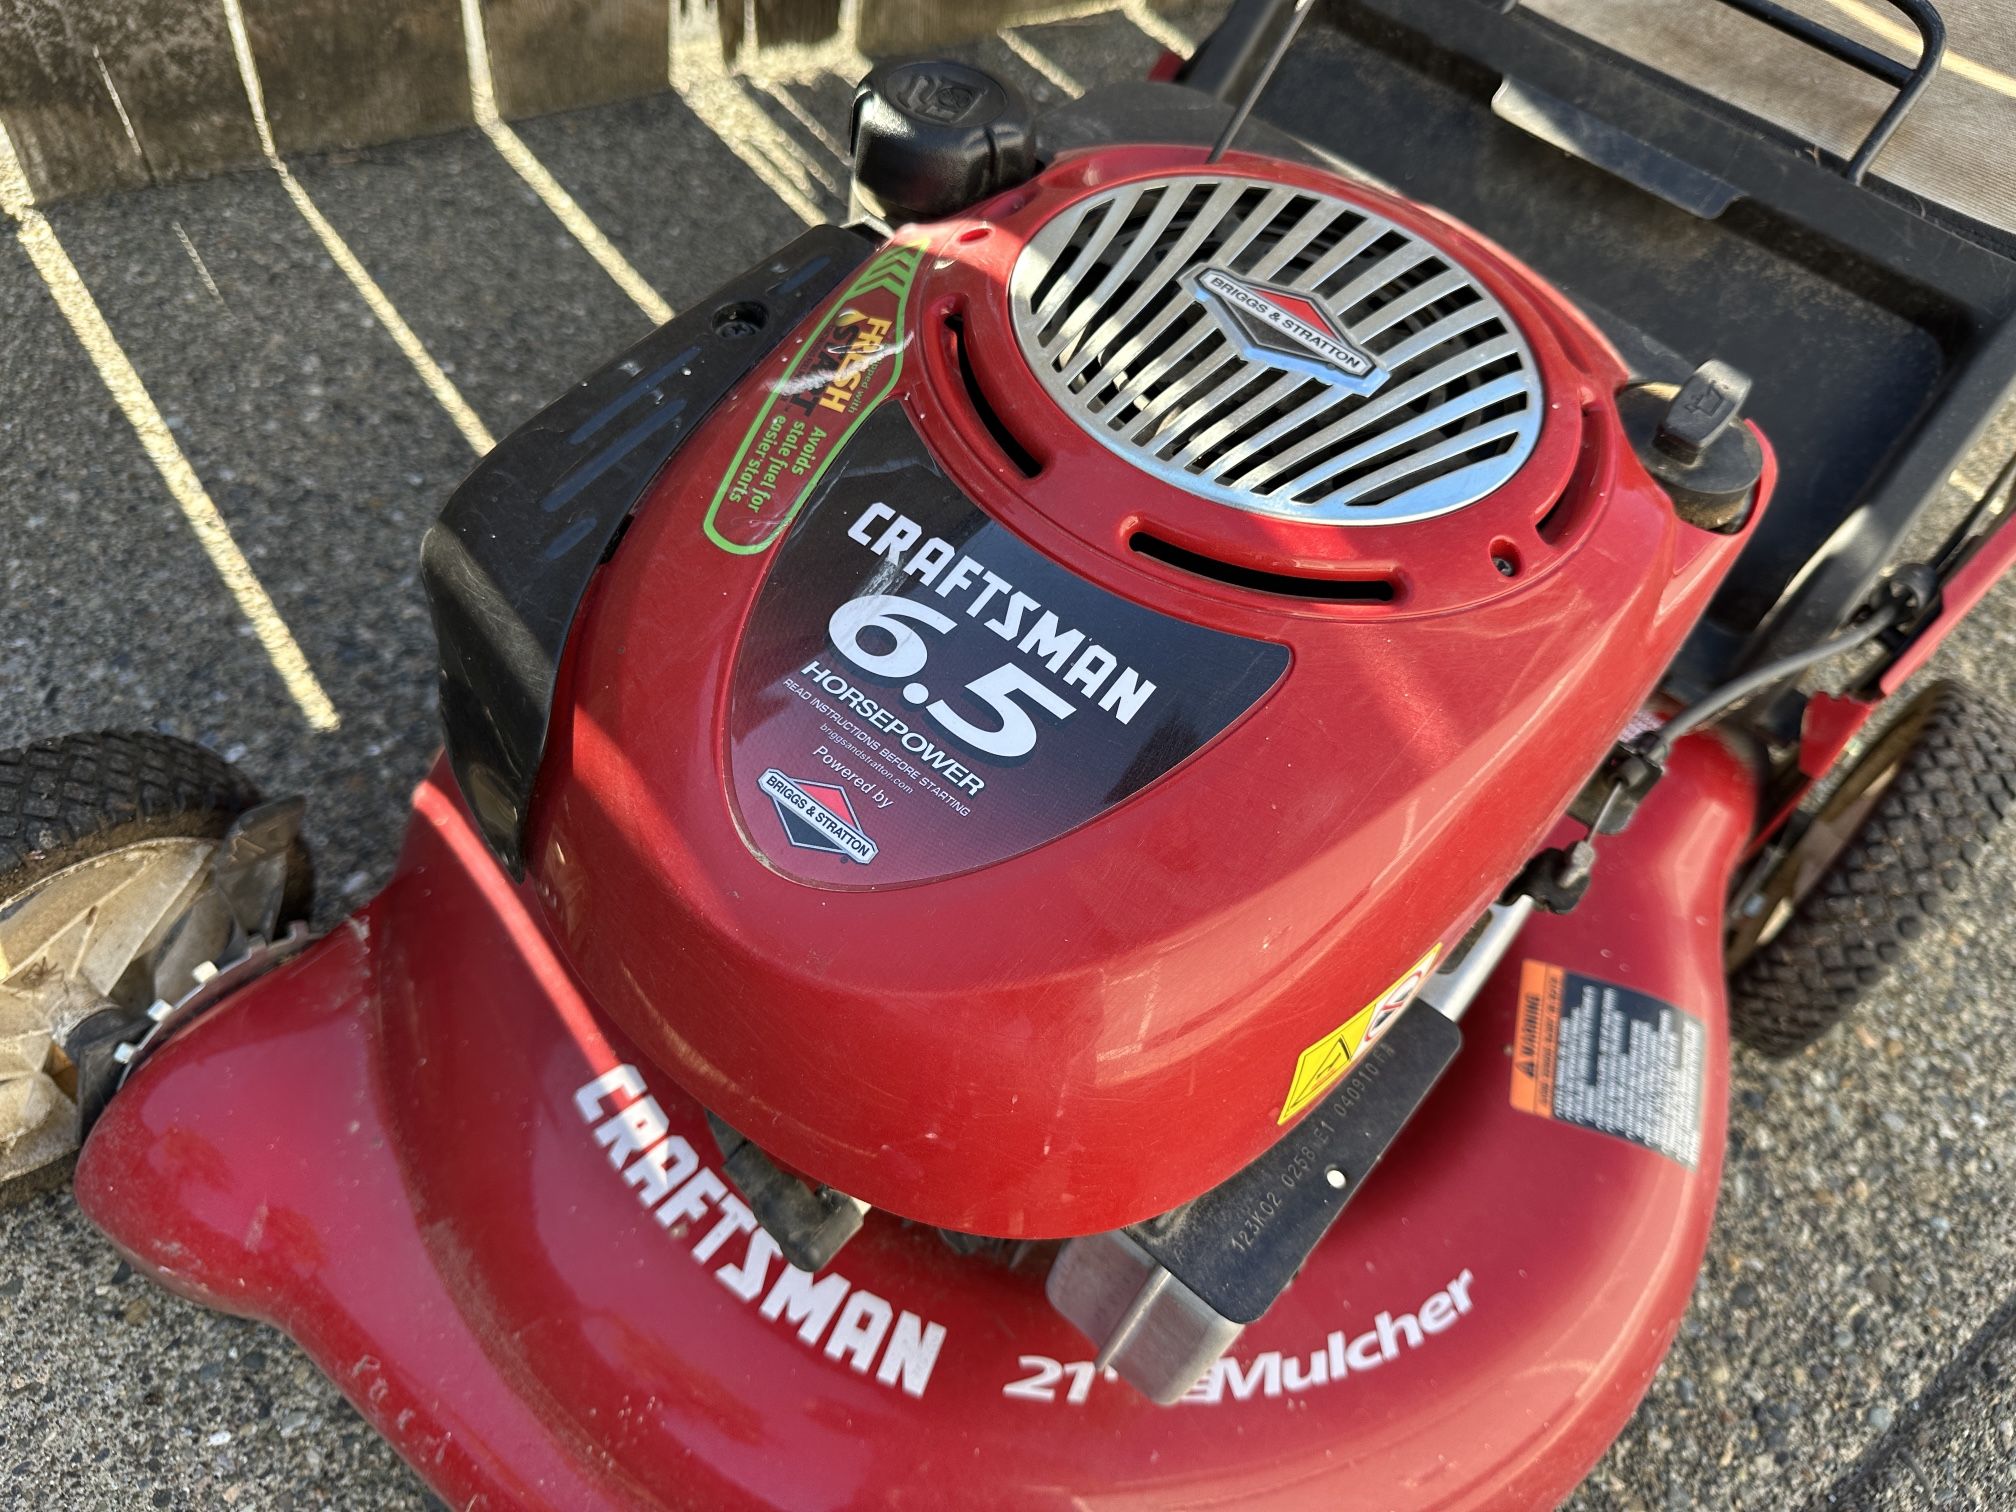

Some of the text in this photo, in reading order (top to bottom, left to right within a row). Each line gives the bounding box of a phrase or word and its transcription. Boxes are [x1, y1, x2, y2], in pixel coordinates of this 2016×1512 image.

[1211, 277, 1361, 368] BRIGGS & STRATTON
[790, 326, 859, 417] STAT
[848, 391, 865, 413] with
[729, 415, 786, 503] easier starts
[748, 421, 805, 513] stale fuel for
[791, 426, 827, 475] Avoids
[847, 502, 1157, 725] CRAFTSMAN
[828, 594, 1077, 757] 6.5
[783, 678, 971, 817] READ INSTRUCTIONS BEFORE STARTING
[801, 661, 985, 797] HORSEPOWER
[820, 723, 914, 794] briggsandstratton.com
[766, 775, 870, 857] BRIGGS & STRATTON
[812, 745, 894, 809] Powered by
[573, 1063, 947, 1399] CRAFTSMAN
